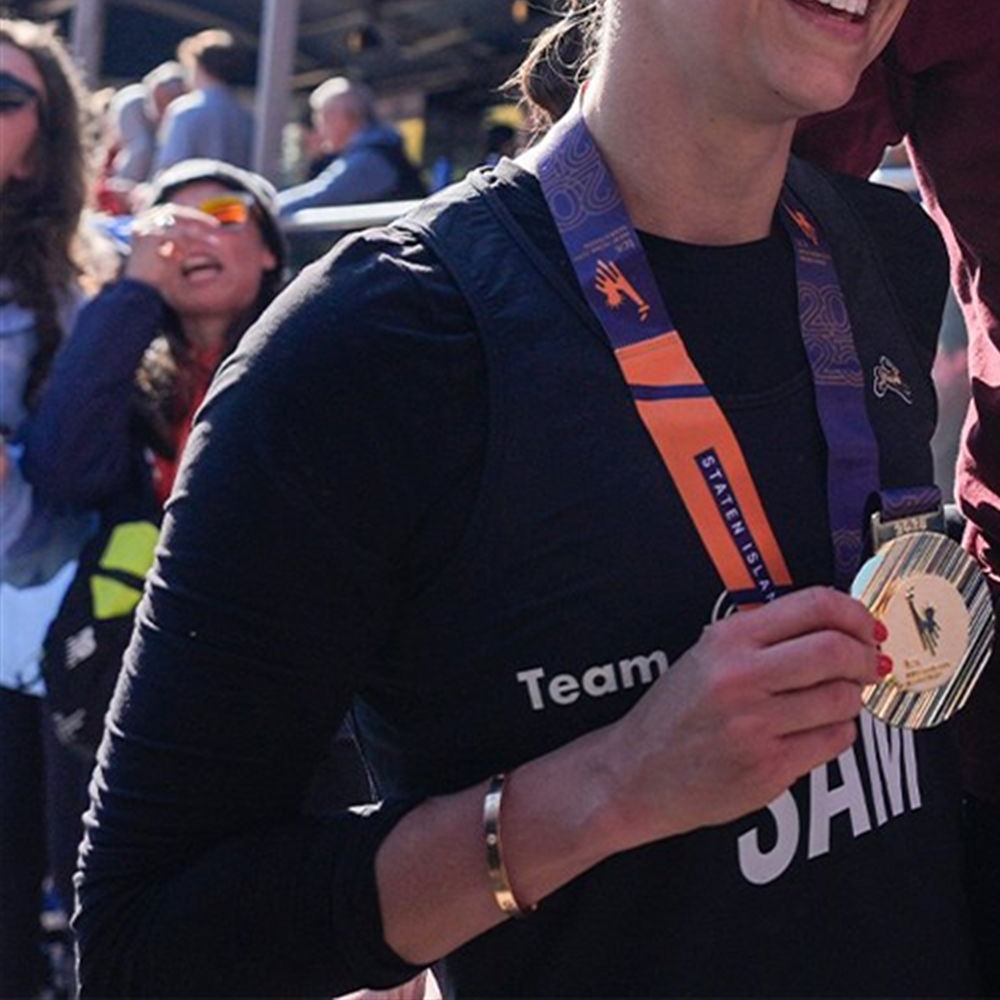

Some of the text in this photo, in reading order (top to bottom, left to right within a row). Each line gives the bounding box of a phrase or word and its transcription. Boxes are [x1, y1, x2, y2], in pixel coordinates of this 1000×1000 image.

[701, 455, 746, 535] STATEN
[516, 650, 669, 711] Team
[737, 706, 922, 886] SAM
